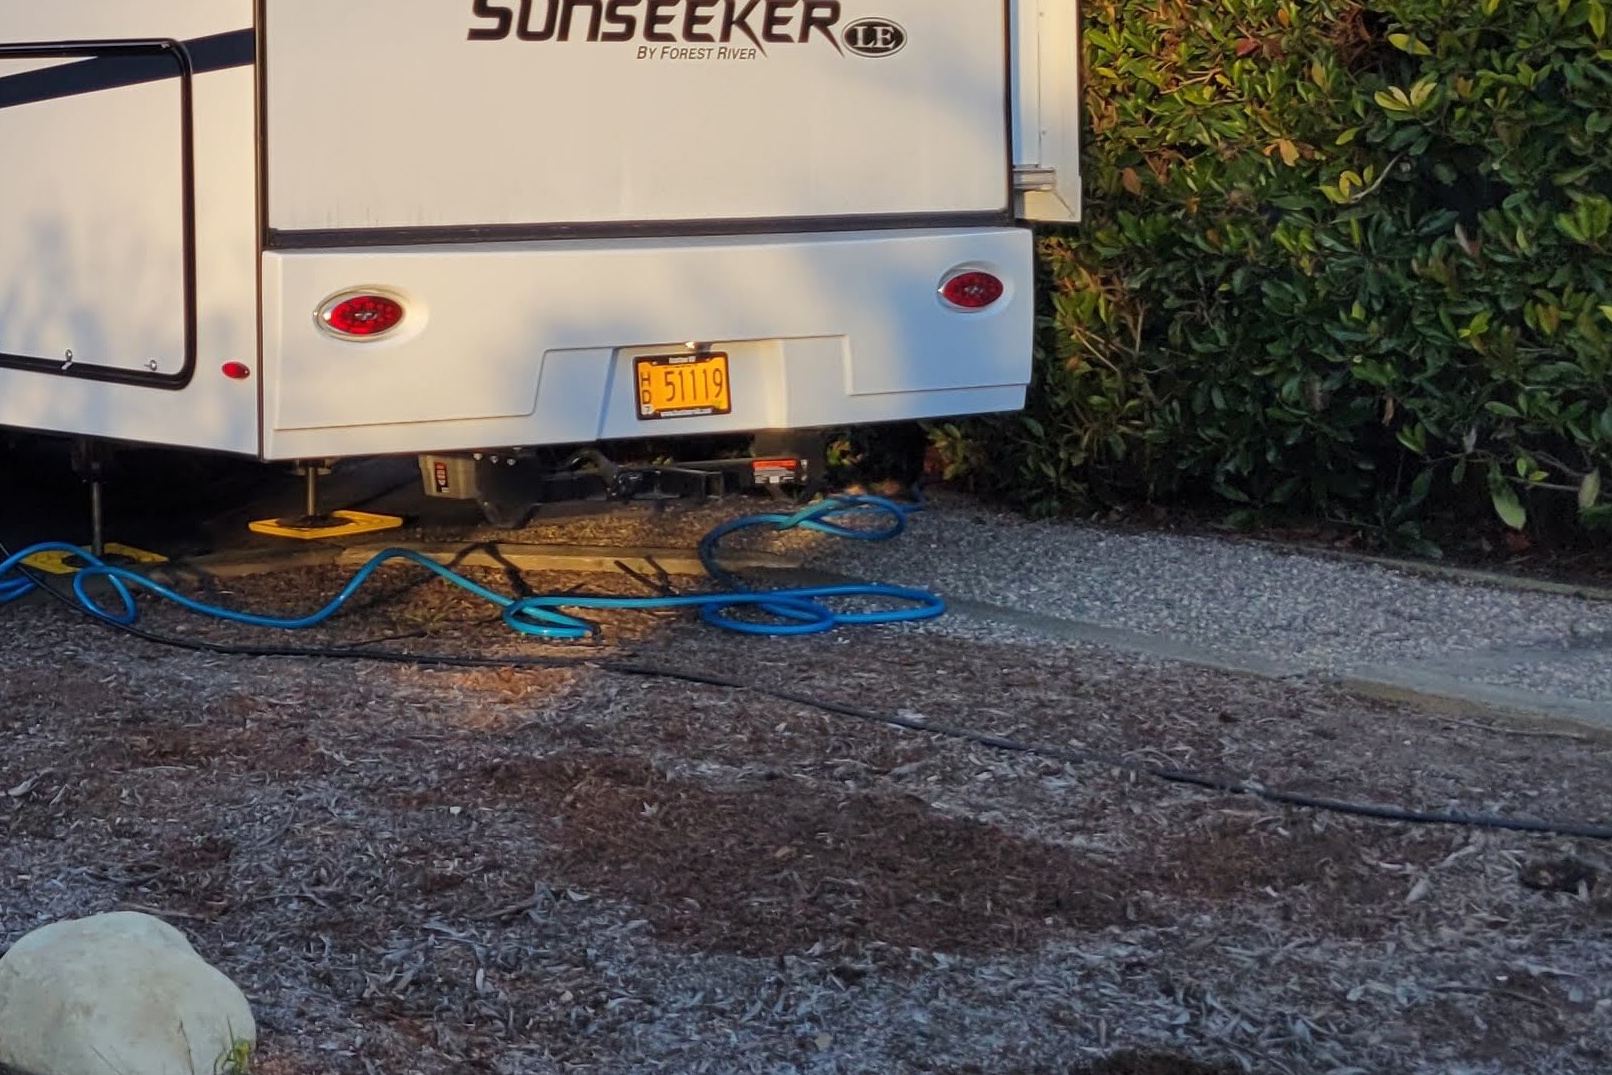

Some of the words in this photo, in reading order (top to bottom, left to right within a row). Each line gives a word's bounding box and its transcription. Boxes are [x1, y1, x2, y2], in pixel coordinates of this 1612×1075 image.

[851, 25, 897, 50] LE
[636, 45, 656, 60] BY
[660, 45, 714, 60] FOREST
[716, 46, 756, 61] RIVER
[664, 367, 723, 403] 51119
